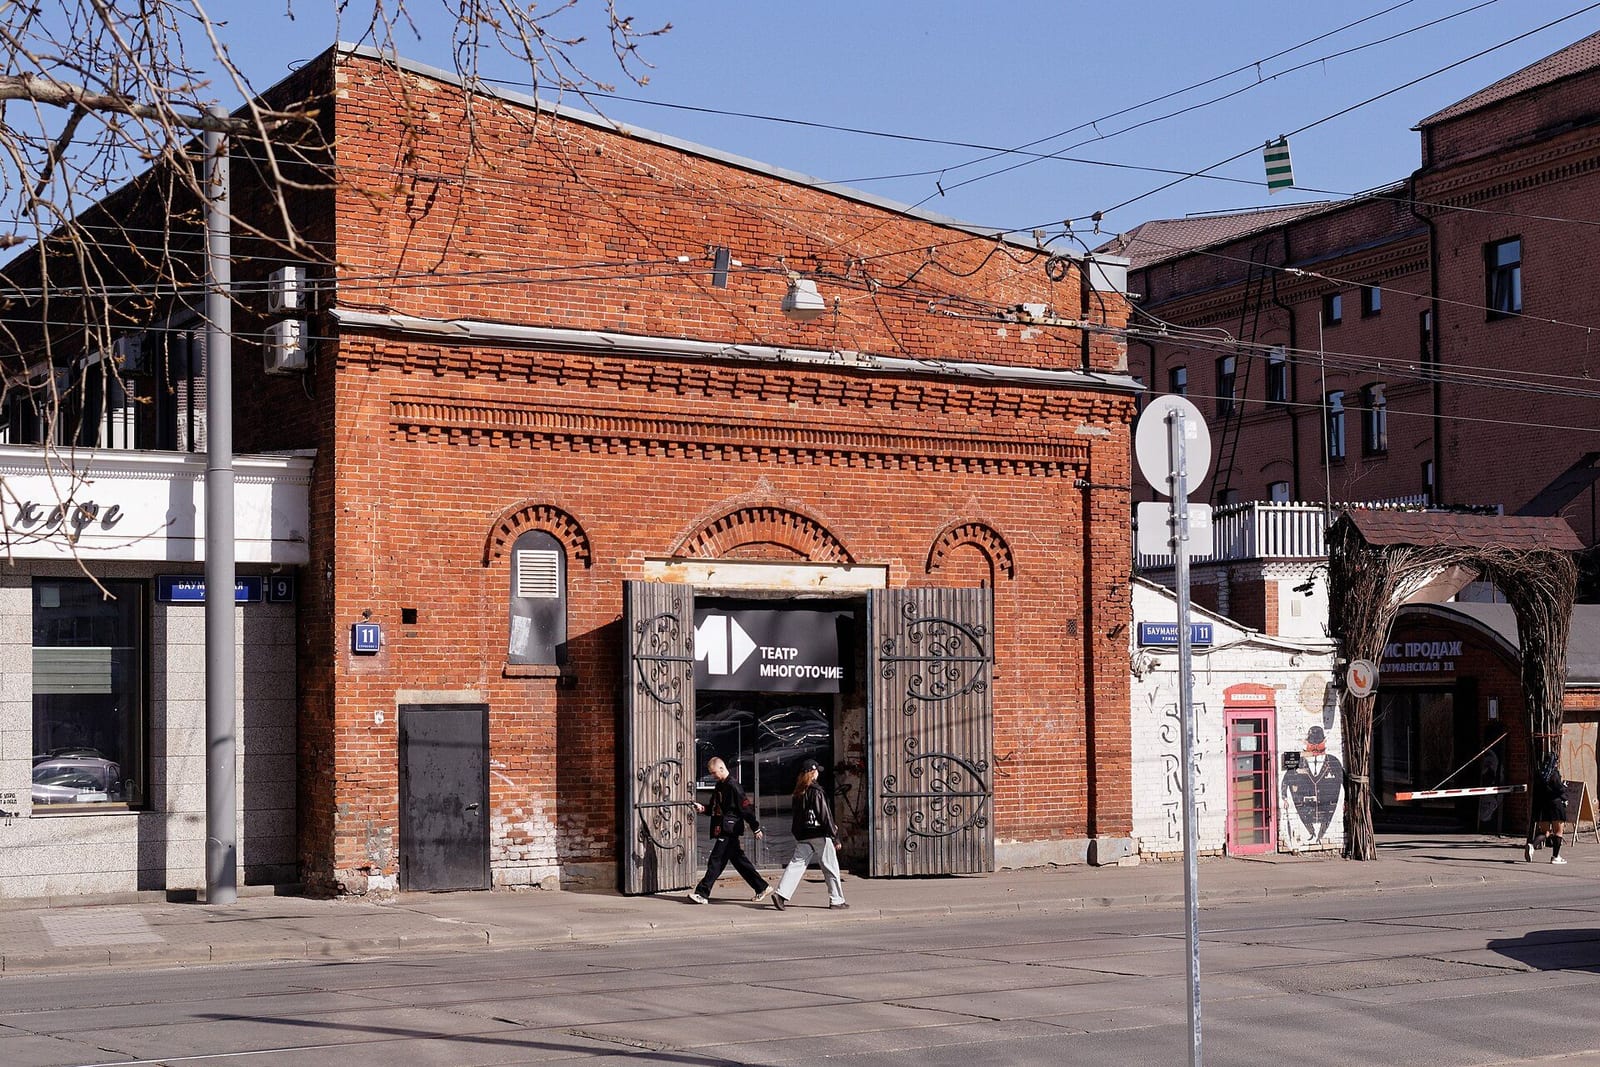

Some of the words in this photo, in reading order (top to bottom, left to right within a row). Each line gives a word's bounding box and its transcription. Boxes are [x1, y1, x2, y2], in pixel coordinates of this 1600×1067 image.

[277, 581, 287, 597] 9
[361, 629, 374, 643] 11
[1200, 627, 1208, 639] 11
[760, 646, 799, 660] ТЕАТР
[1405, 641, 1463, 660] ПРОДАЖ
[760, 664, 844, 679] МНОГОТОЧИЕ
[1379, 662, 1440, 672] АУМАНСКАЯ
